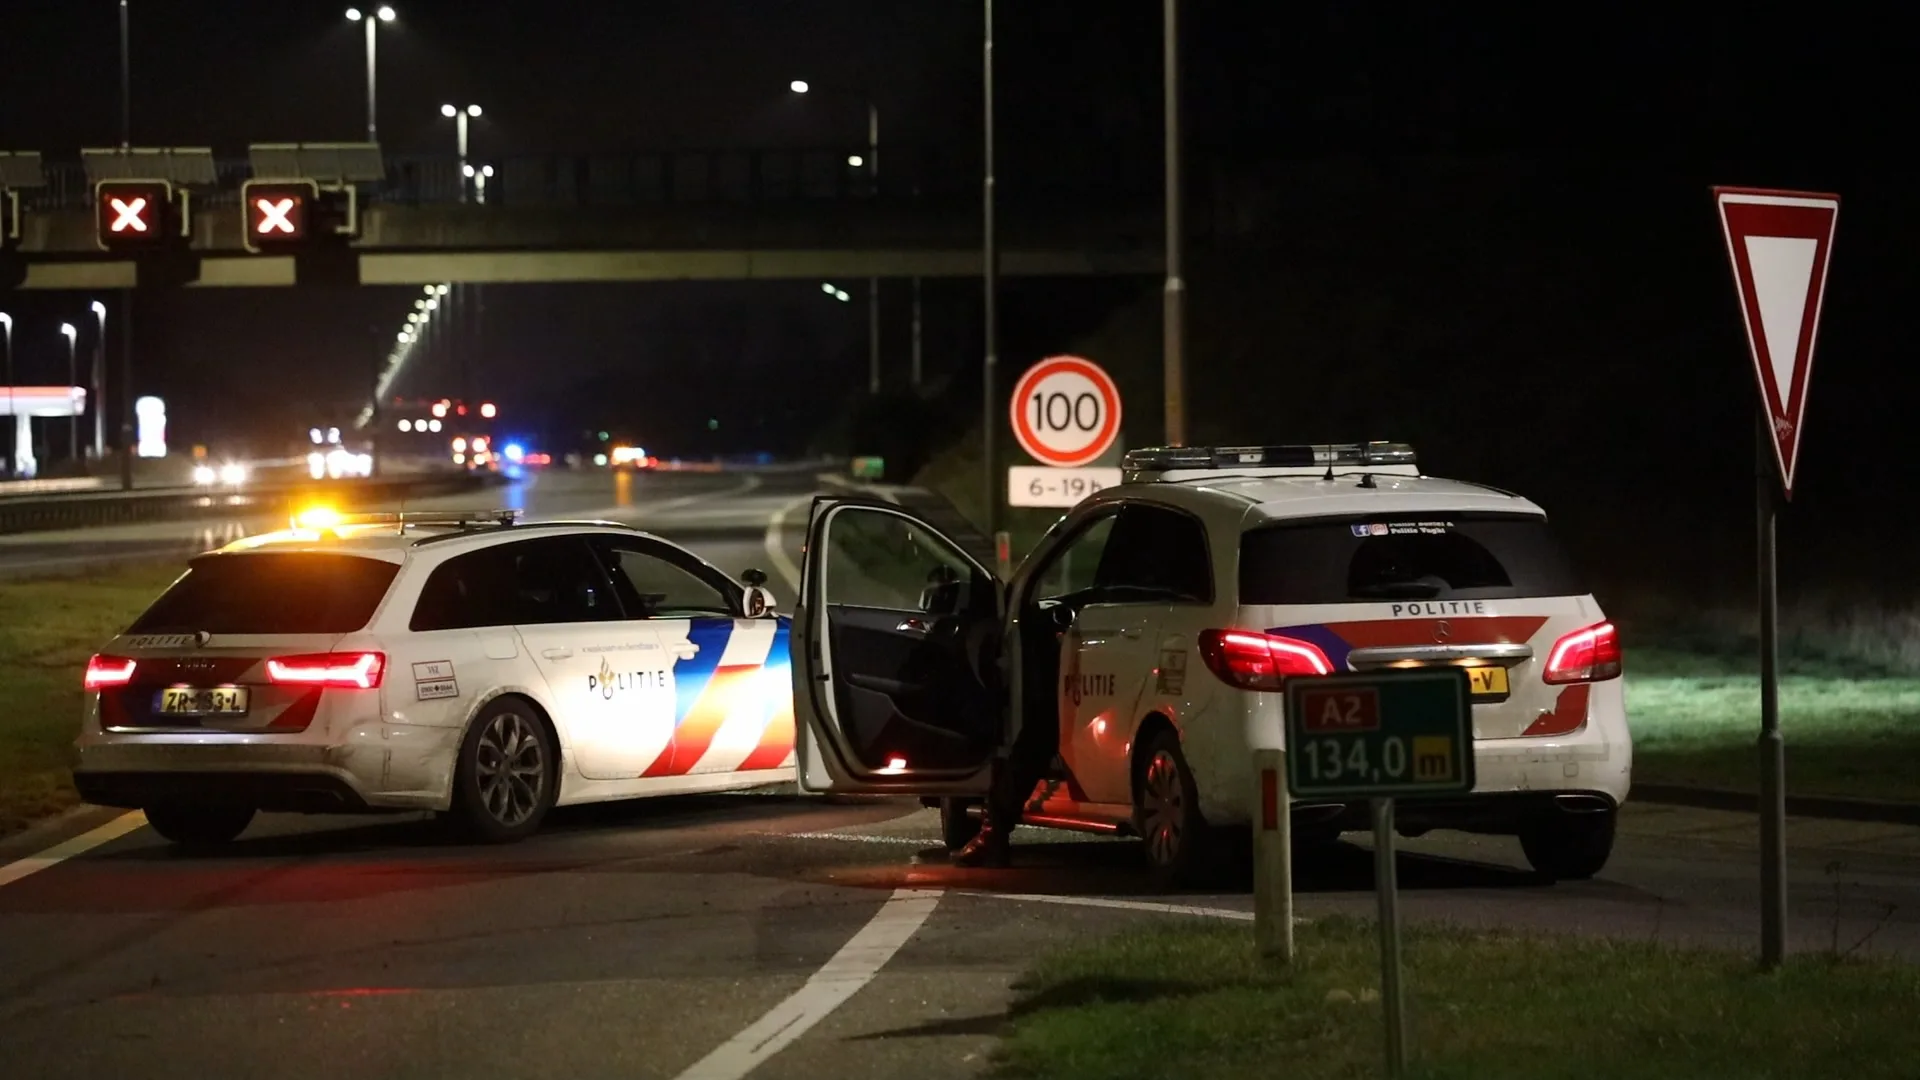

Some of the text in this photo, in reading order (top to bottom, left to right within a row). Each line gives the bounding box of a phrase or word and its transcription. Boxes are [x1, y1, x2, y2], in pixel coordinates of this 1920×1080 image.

[1033, 392, 1099, 431] 100
[1391, 601, 1484, 617] POLITIE
[128, 635, 192, 646] POLITIE
[588, 669, 665, 700] POLITIE
[1320, 696, 1362, 725] A2
[1303, 735, 1406, 784] 134,0
